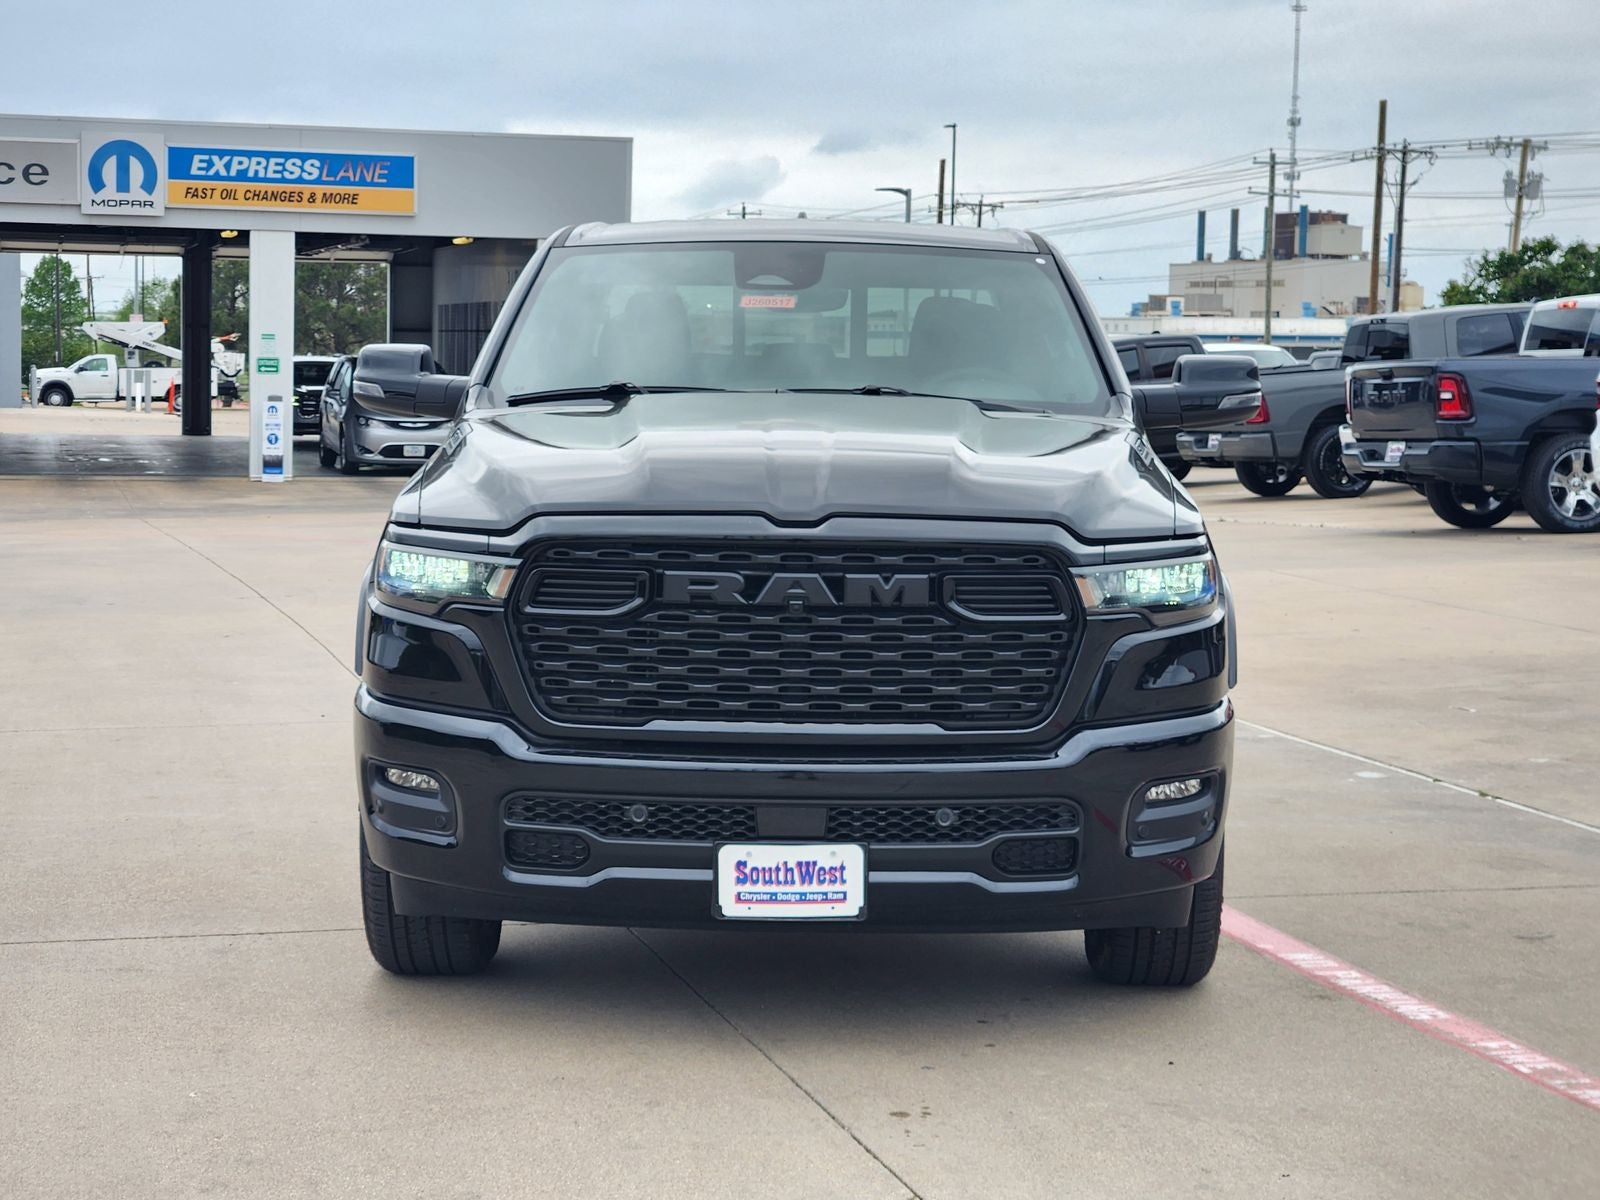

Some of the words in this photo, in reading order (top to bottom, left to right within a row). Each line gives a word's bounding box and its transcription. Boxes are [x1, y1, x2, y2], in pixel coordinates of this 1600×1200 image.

[91, 199, 155, 208] MOPAR
[184, 187, 217, 200] FAST
[220, 188, 239, 201] OIL
[243, 189, 304, 203] CHANGES
[307, 192, 317, 204] &
[321, 192, 360, 205] MORE
[1366, 389, 1408, 404] RAM
[663, 570, 930, 607] RAM
[735, 860, 847, 886] SouthWest
[740, 892, 770, 902] Chrysler
[777, 892, 800, 902] Dodge
[806, 892, 823, 902] Jeep
[827, 892, 844, 900] Ram
